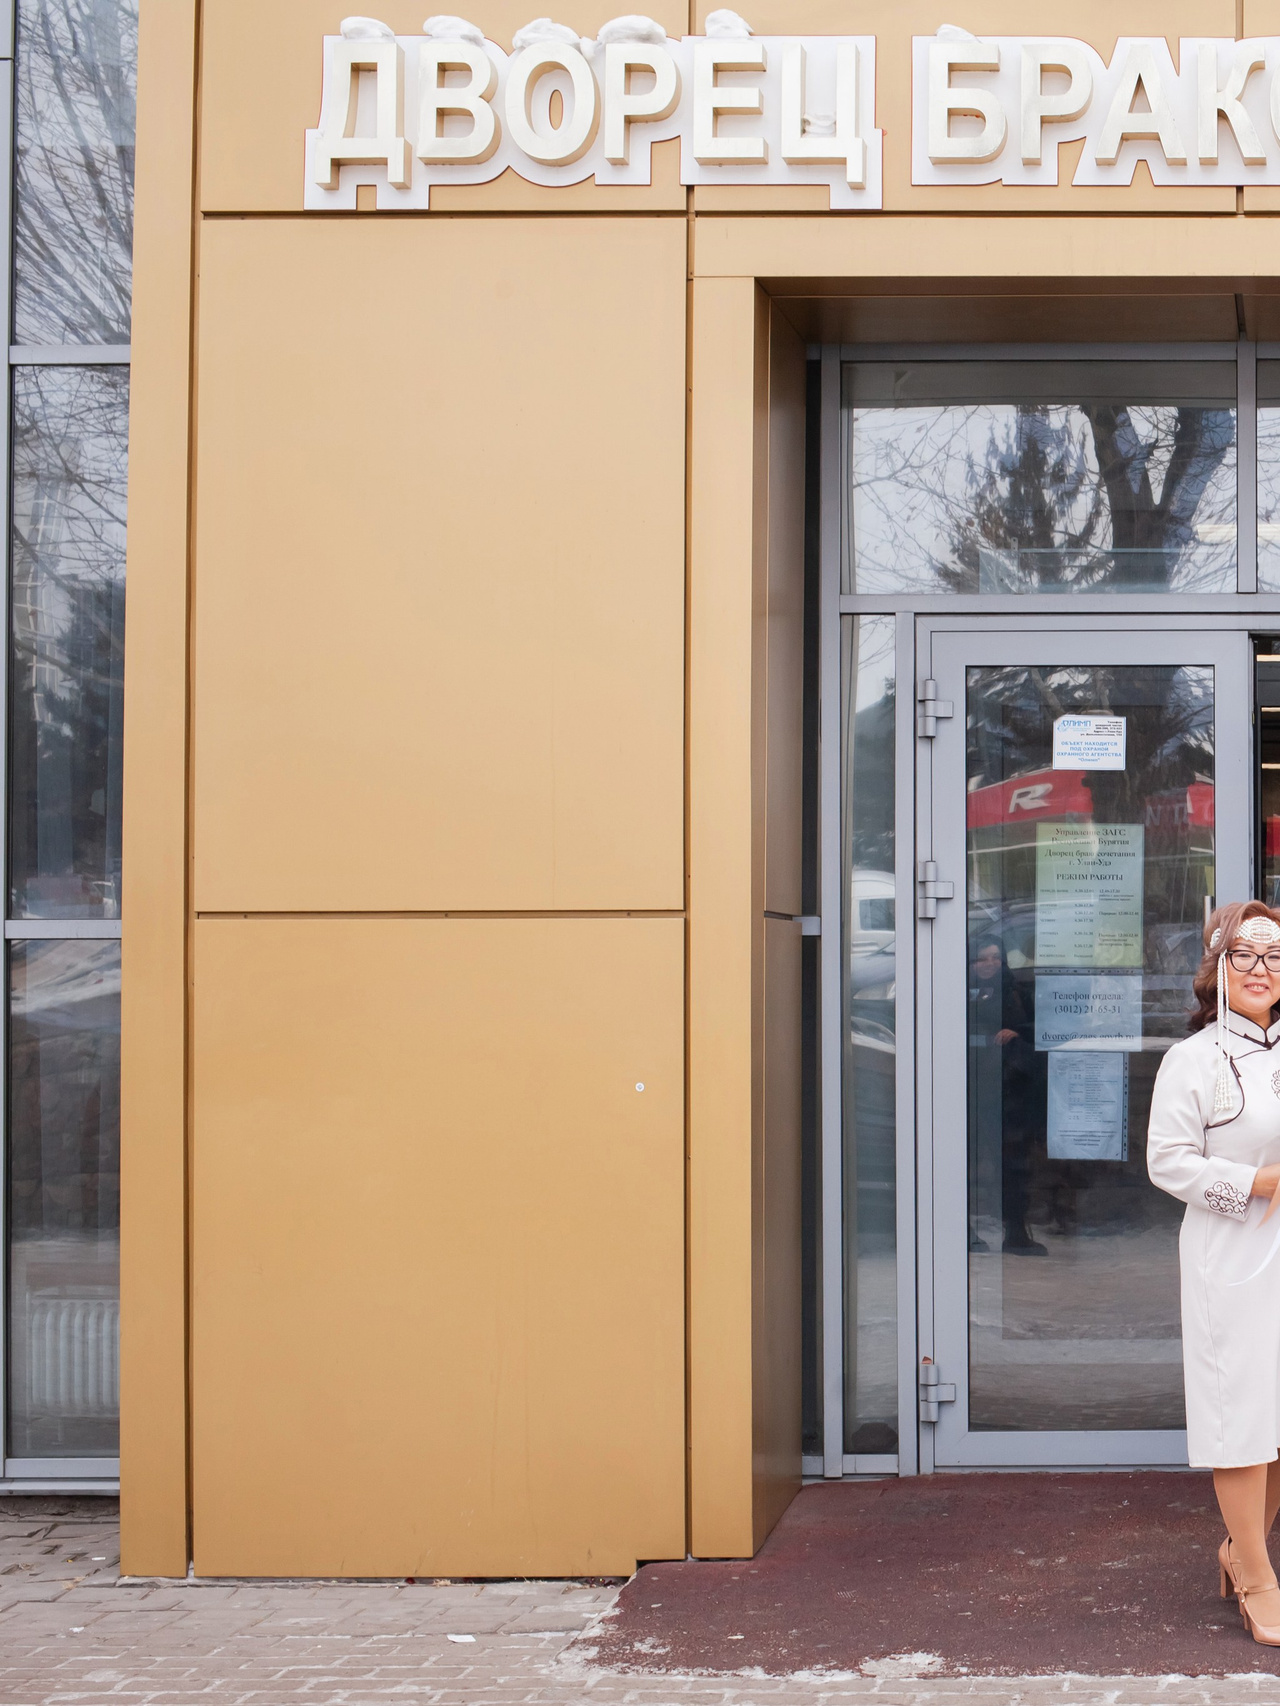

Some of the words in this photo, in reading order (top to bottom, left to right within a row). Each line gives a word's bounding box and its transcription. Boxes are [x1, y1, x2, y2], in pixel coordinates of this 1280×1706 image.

[314, 40, 868, 191] ДВОРЕЦ
[1102, 828, 1126, 836] ЗАГС
[1051, 837, 1096, 846] Рспублии
[1098, 838, 1130, 846] Бурятия
[1044, 849, 1074, 858] Дворец
[1077, 858, 1112, 866] Улан-Удэ
[1053, 992, 1090, 1002] Телефон
[1054, 1005, 1082, 1014] (3012)
[1084, 1005, 1121, 1013] 21-65-31
[1042, 1032, 1134, 1041] dvorec@zagsgovrbru
